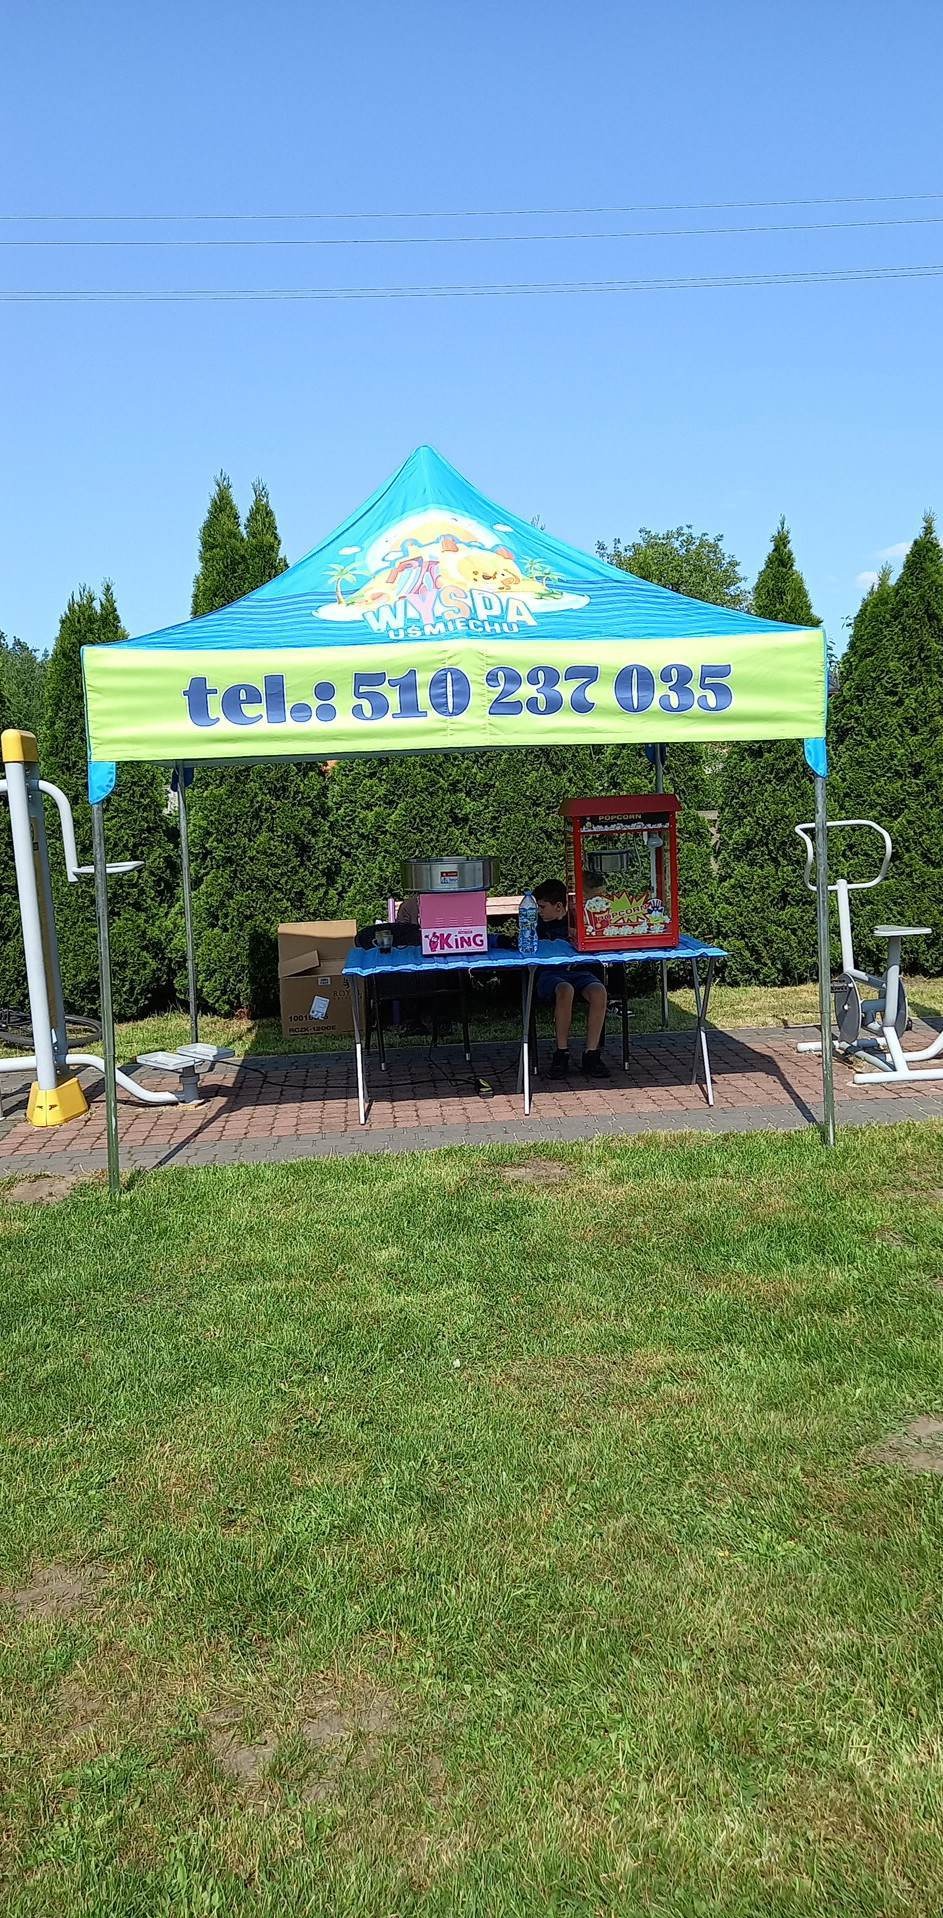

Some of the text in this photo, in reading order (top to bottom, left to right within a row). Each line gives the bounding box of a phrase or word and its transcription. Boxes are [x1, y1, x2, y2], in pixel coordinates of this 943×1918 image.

[362, 586, 538, 633] WYSPA
[183, 663, 733, 727] tel.: 510 237 035
